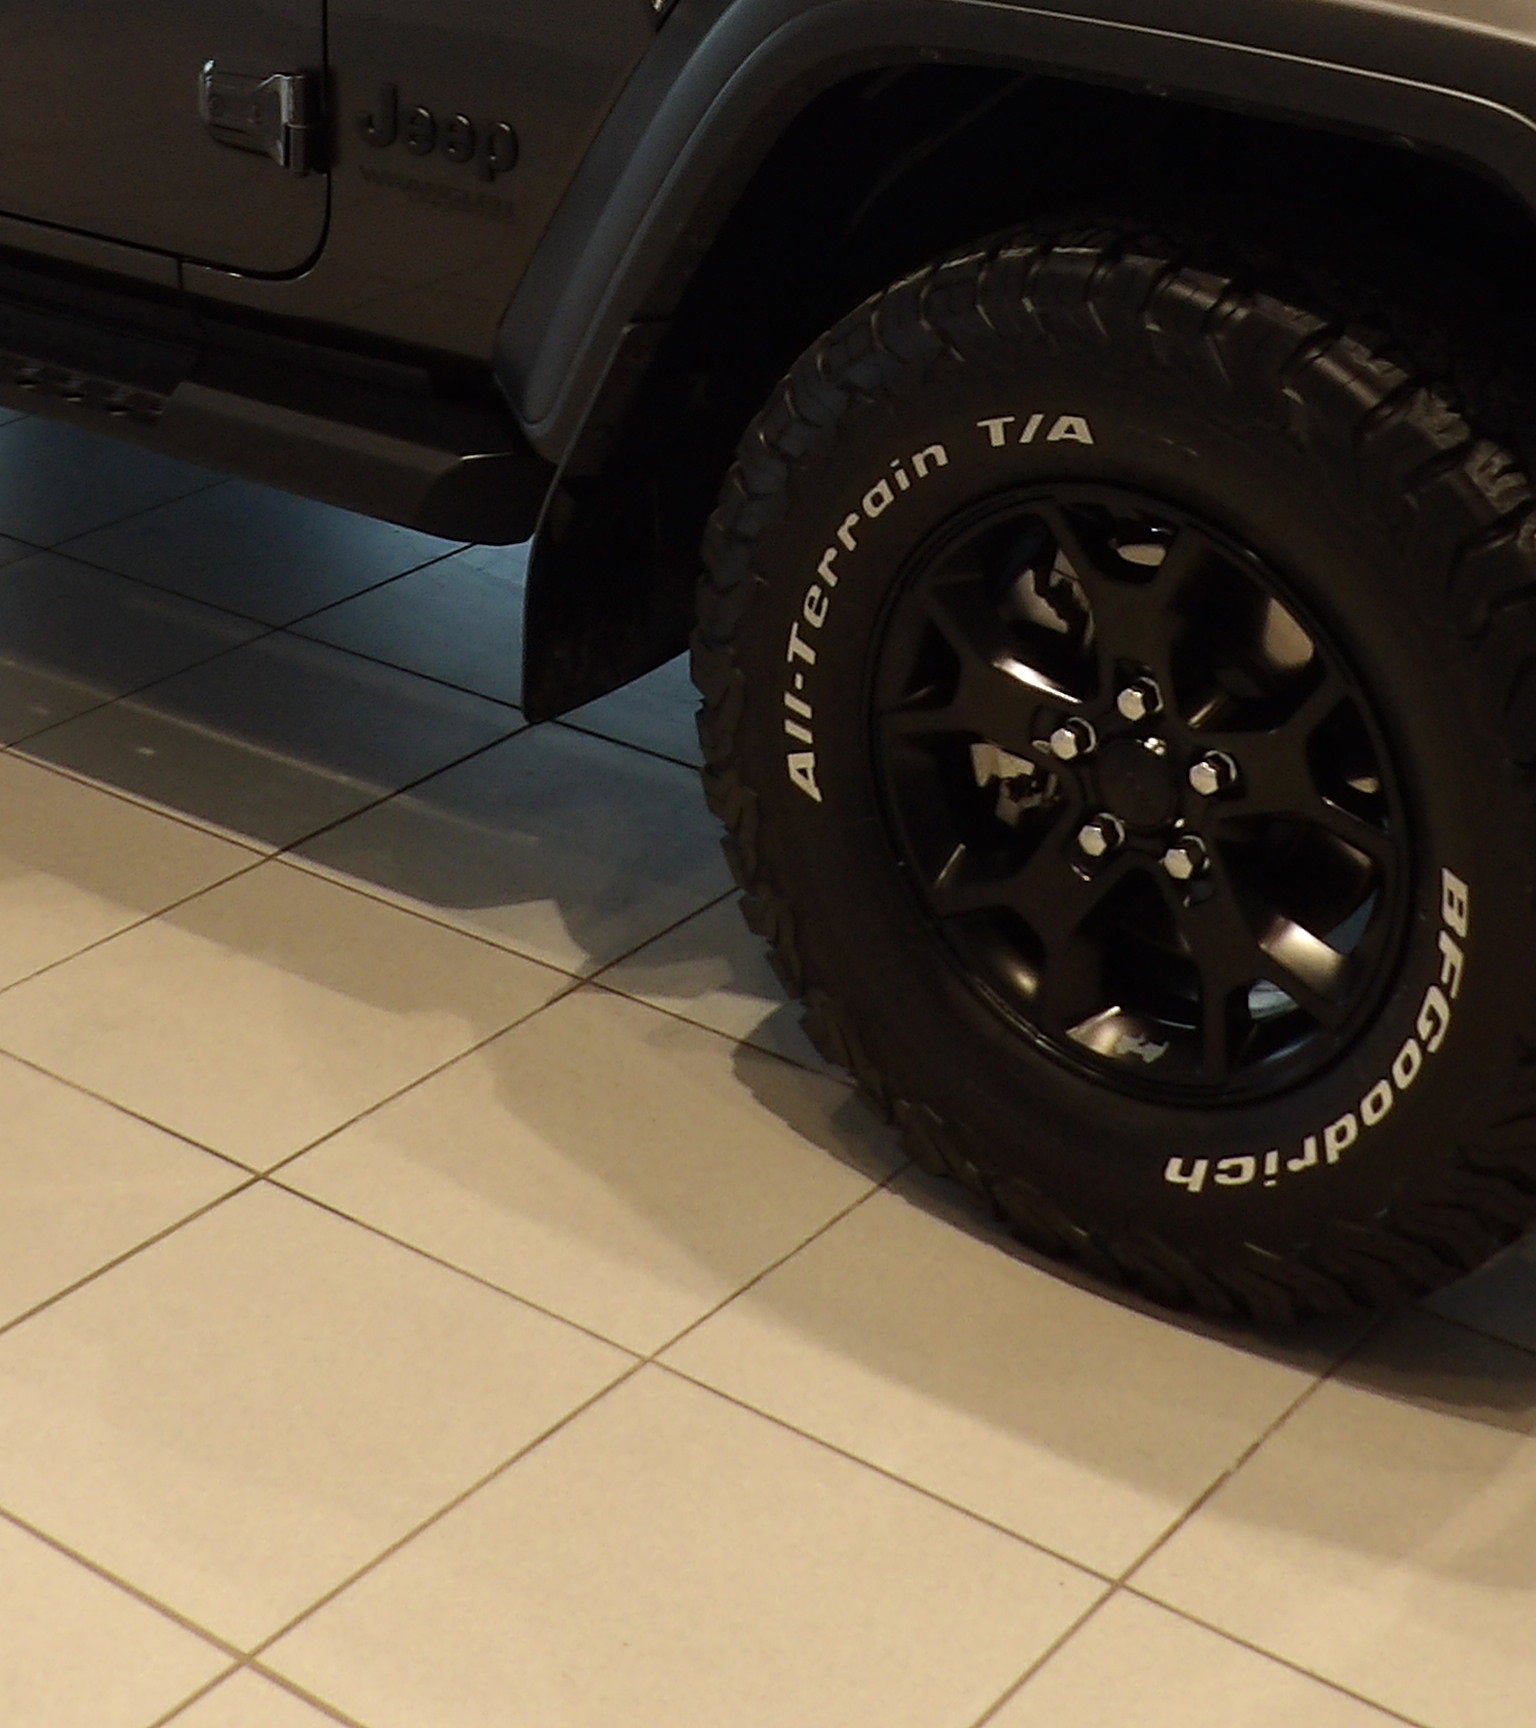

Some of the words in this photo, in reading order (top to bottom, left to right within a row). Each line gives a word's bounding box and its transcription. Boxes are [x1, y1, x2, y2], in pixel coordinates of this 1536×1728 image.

[356, 82, 520, 182] Jeep
[782, 441, 949, 803] All-Terrain
[977, 411, 1096, 448] T/A
[1164, 867, 1470, 1194] BFGoodrich
